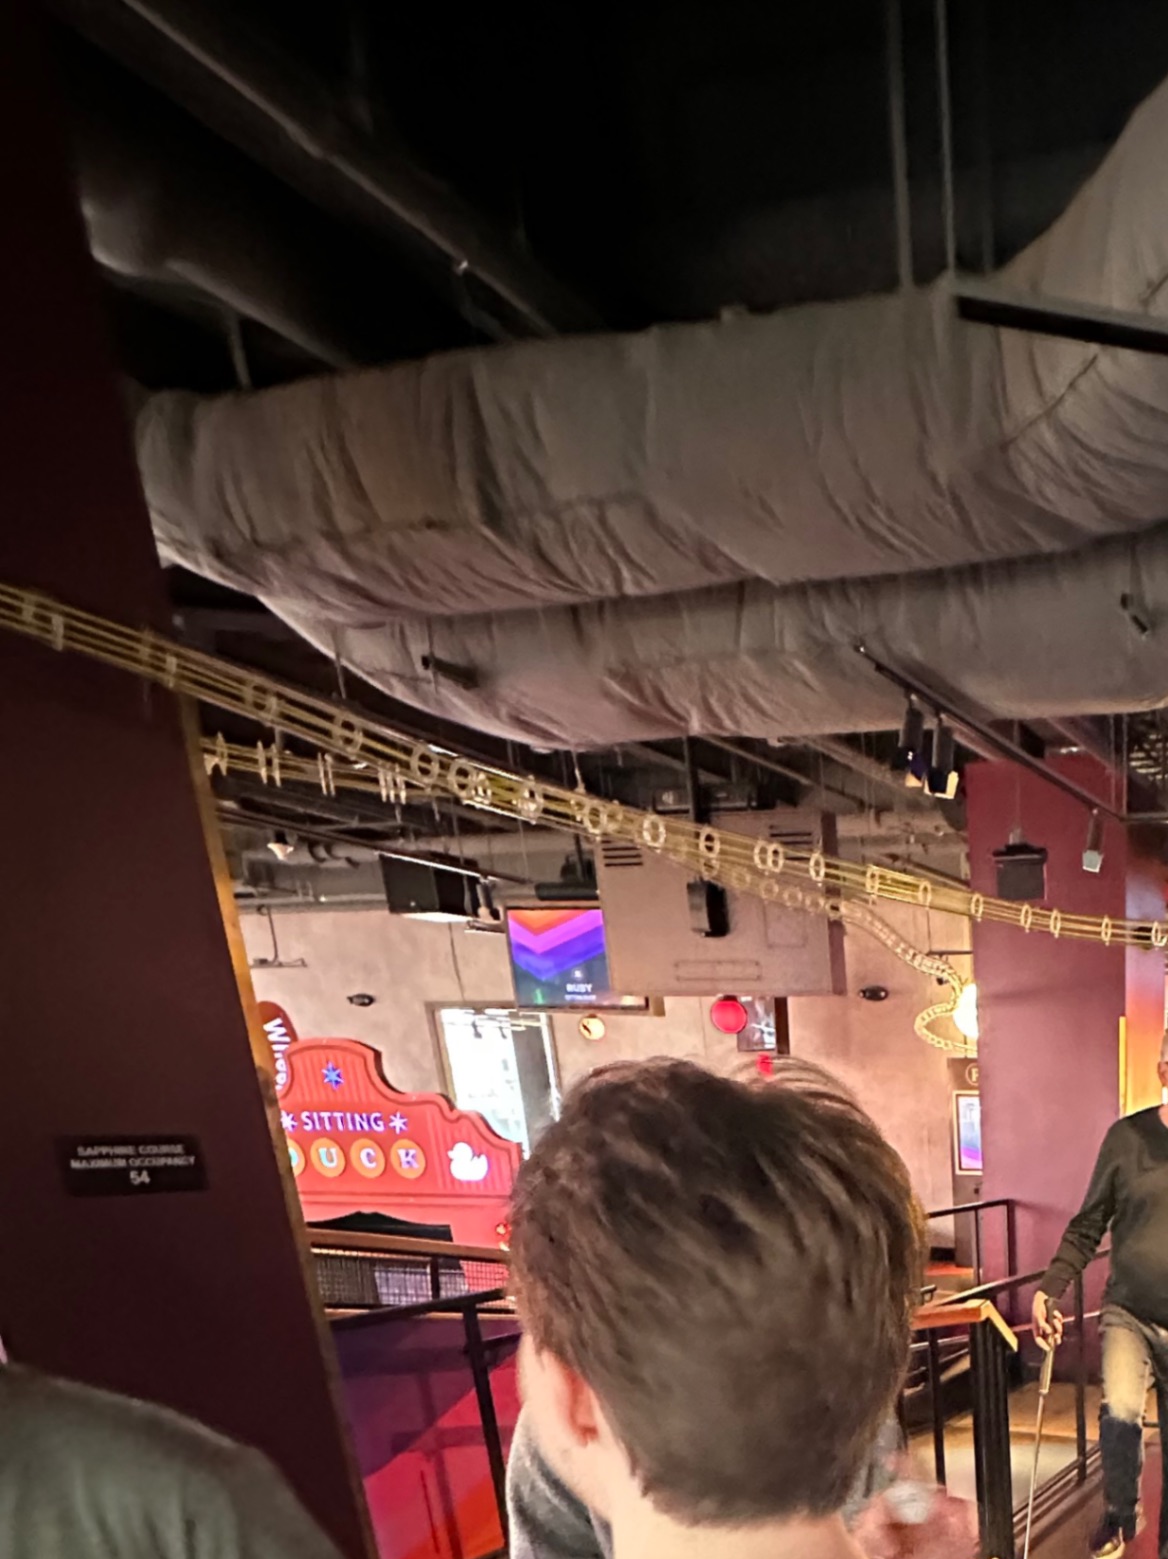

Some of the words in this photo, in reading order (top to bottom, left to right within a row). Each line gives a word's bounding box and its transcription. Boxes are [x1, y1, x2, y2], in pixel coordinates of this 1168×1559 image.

[301, 1110, 385, 1132] SITTING
[77, 1145, 136, 1157] SAPPHIRE
[138, 1144, 184, 1155] COURSE
[70, 1158, 127, 1169] MAXIMUM
[128, 1155, 195, 1167] OCCUPANCY
[129, 1170, 151, 1185] 54
